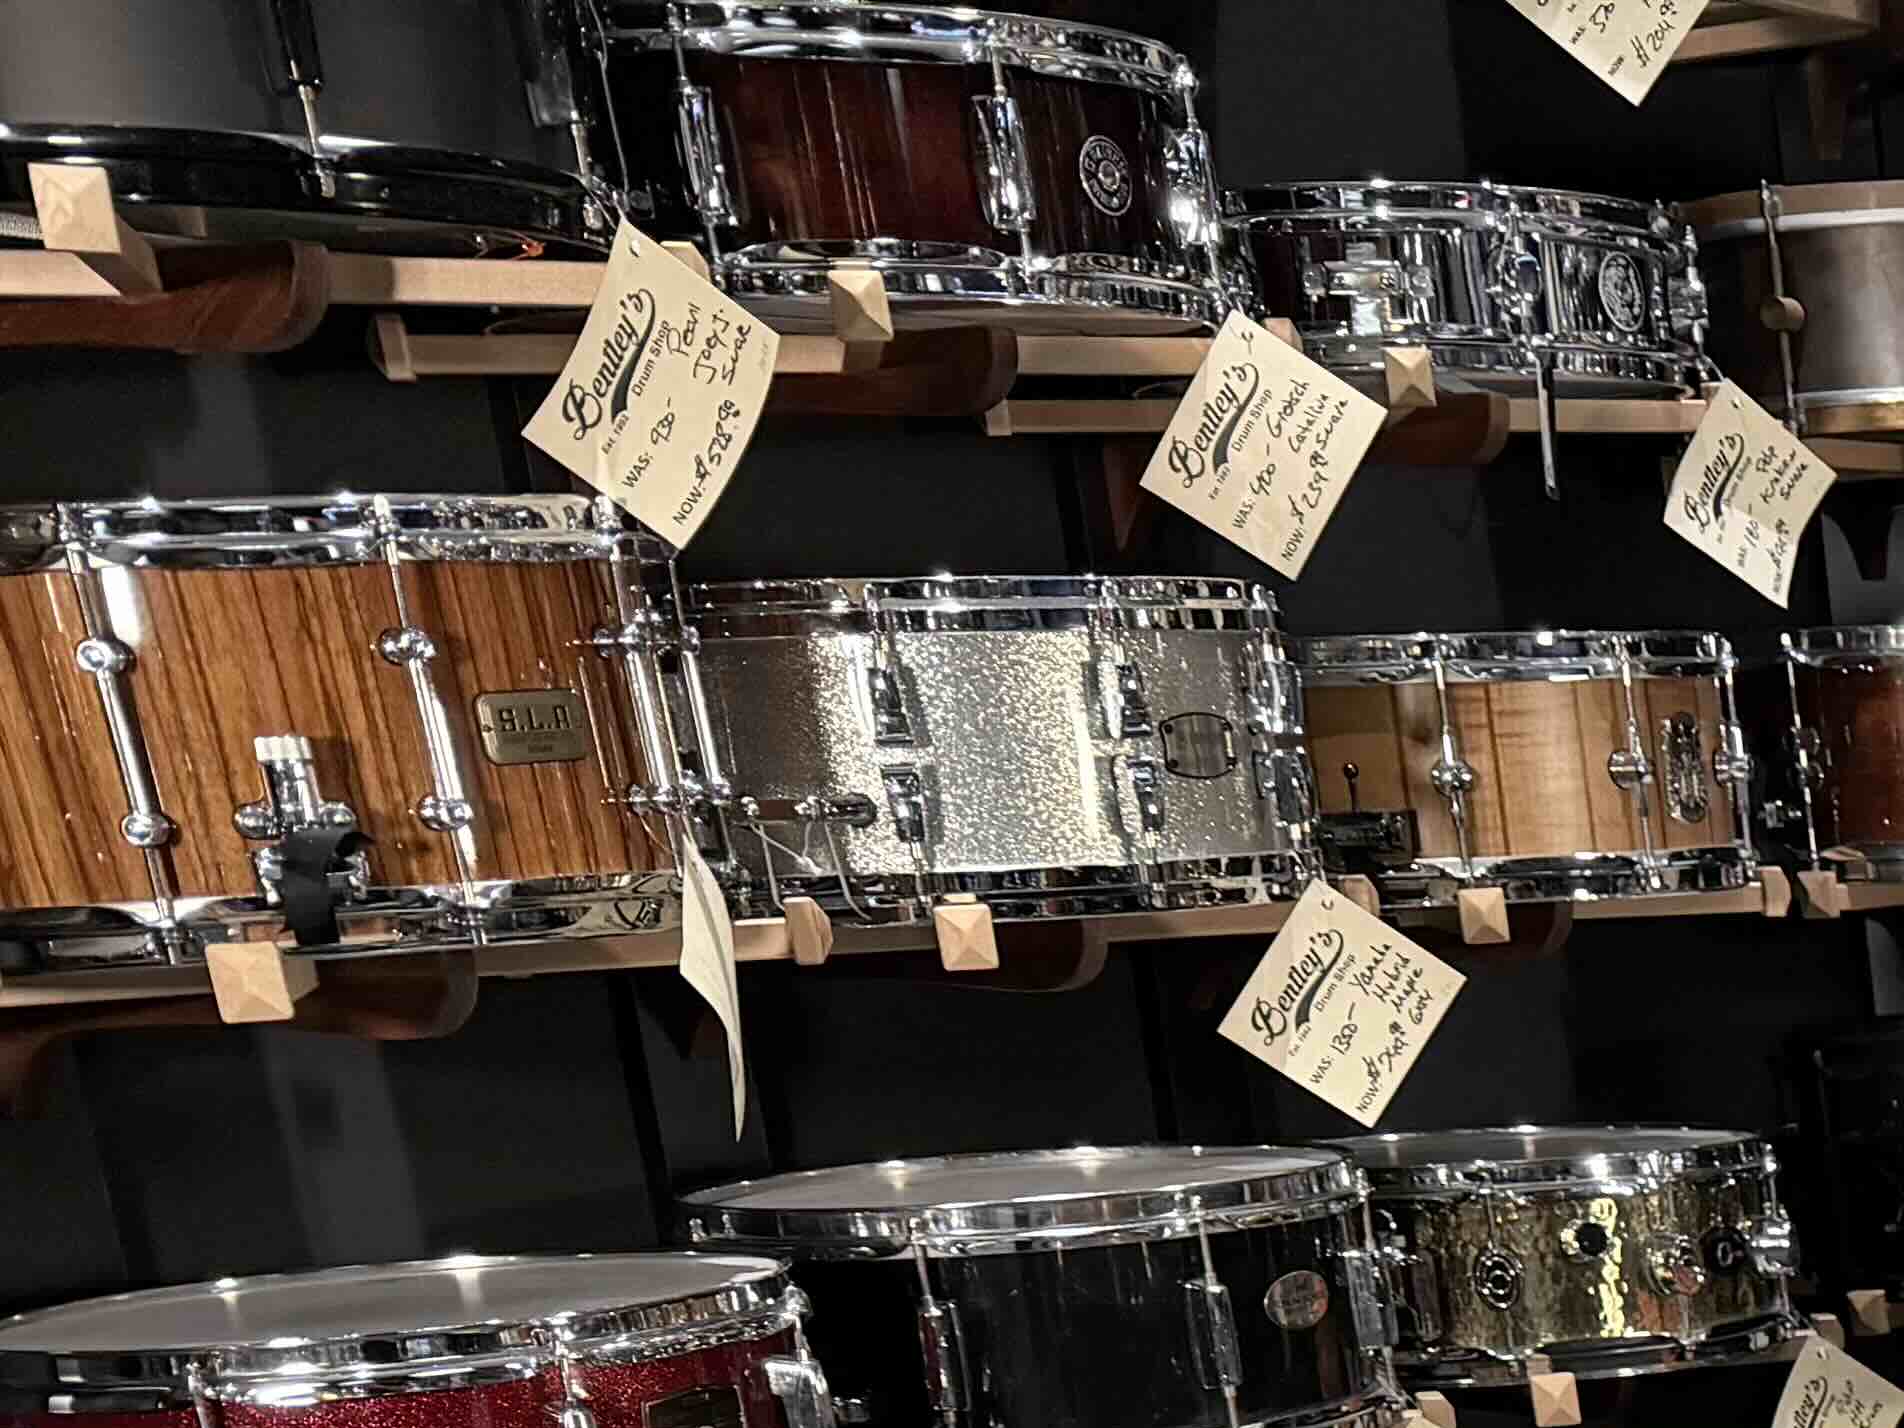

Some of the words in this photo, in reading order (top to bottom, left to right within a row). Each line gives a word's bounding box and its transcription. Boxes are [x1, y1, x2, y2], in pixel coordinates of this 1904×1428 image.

[562, 287, 656, 441] Bentley's
[631, 355, 659, 397] Drum
[651, 319, 670, 357] Shop
[1168, 362, 1260, 489] Bentley's
[1230, 417, 1258, 453] Drum
[1251, 388, 1273, 420] Shop
[622, 451, 655, 489] WAS:
[1684, 433, 1745, 535] Bentley's
[1232, 497, 1257, 530] WAS:
[1251, 928, 1345, 1047] Bentley's
[1313, 980, 1339, 1014] Drum
[1335, 952, 1357, 983] Shop
[1308, 1054, 1334, 1085] WAS:
